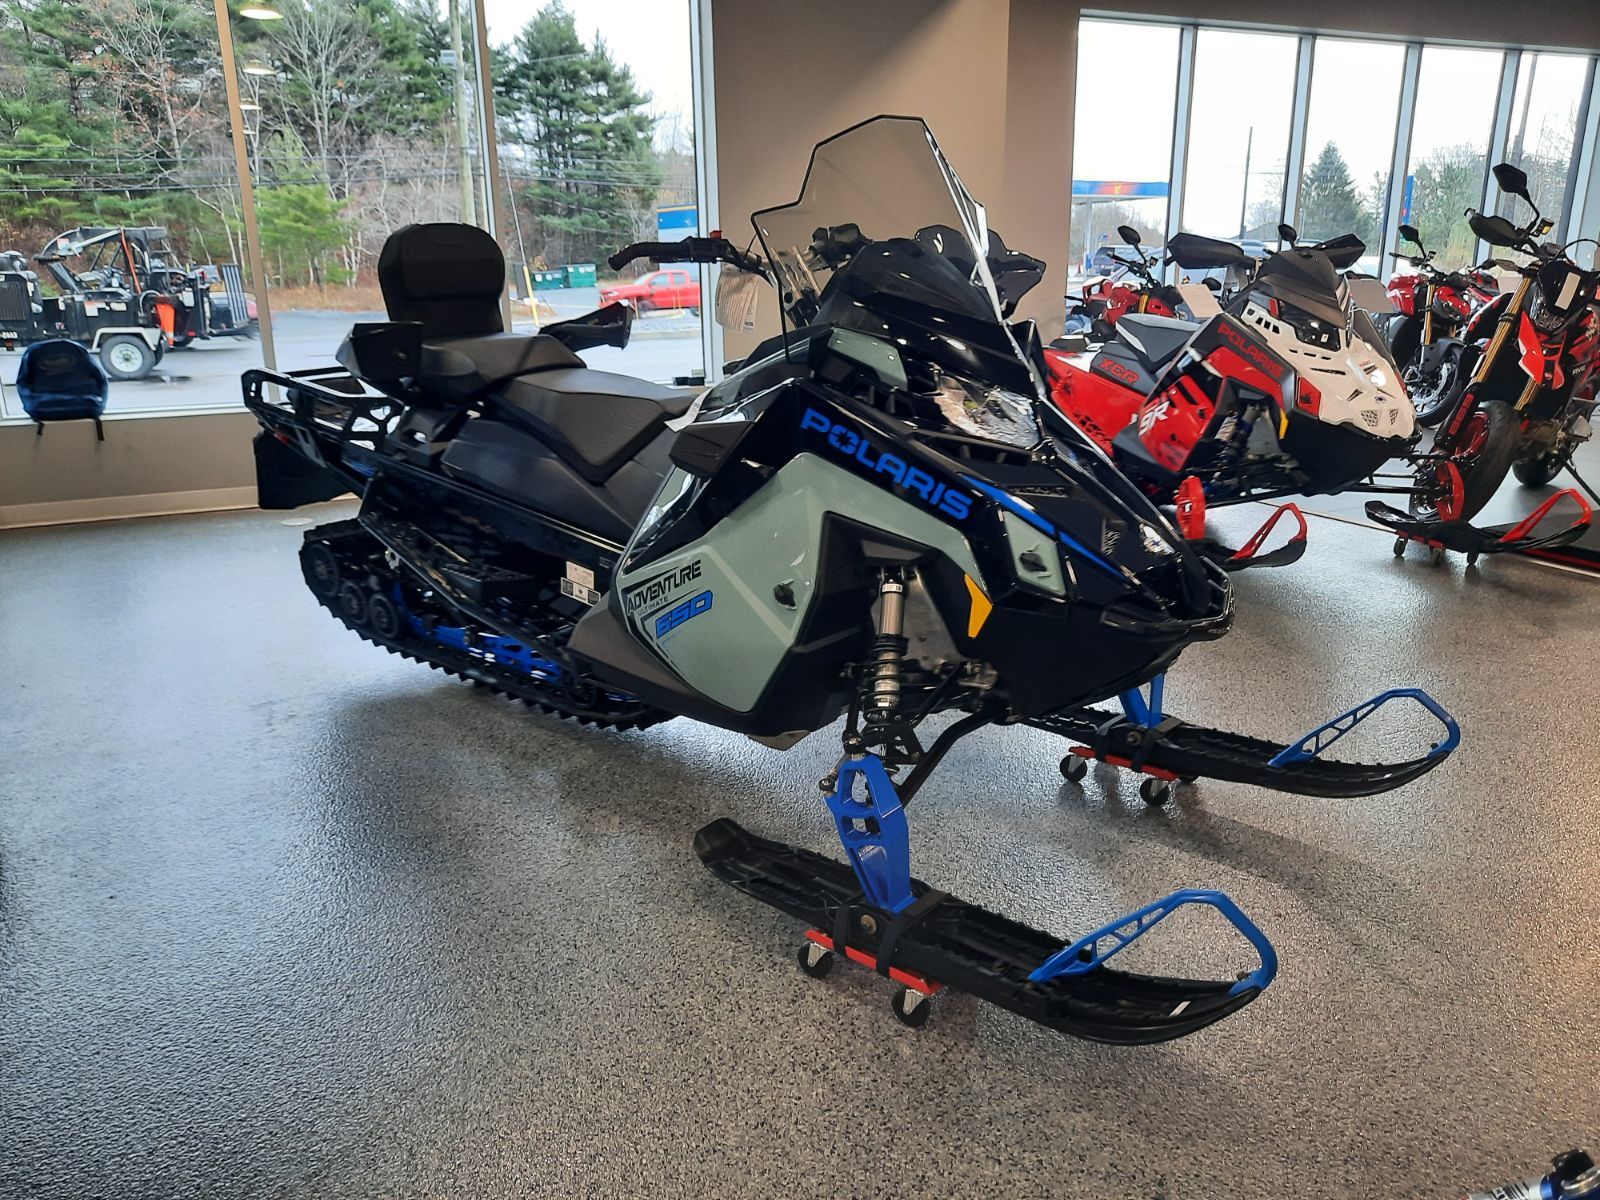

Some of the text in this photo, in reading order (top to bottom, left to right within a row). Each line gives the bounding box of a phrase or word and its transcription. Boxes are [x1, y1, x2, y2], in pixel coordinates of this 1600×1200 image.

[1098, 358, 1140, 384] XCR
[1218, 322, 1284, 378] POLARIS
[801, 407, 974, 520] POLARIS
[626, 559, 702, 616] ADVENTURE
[655, 589, 713, 639] 650
